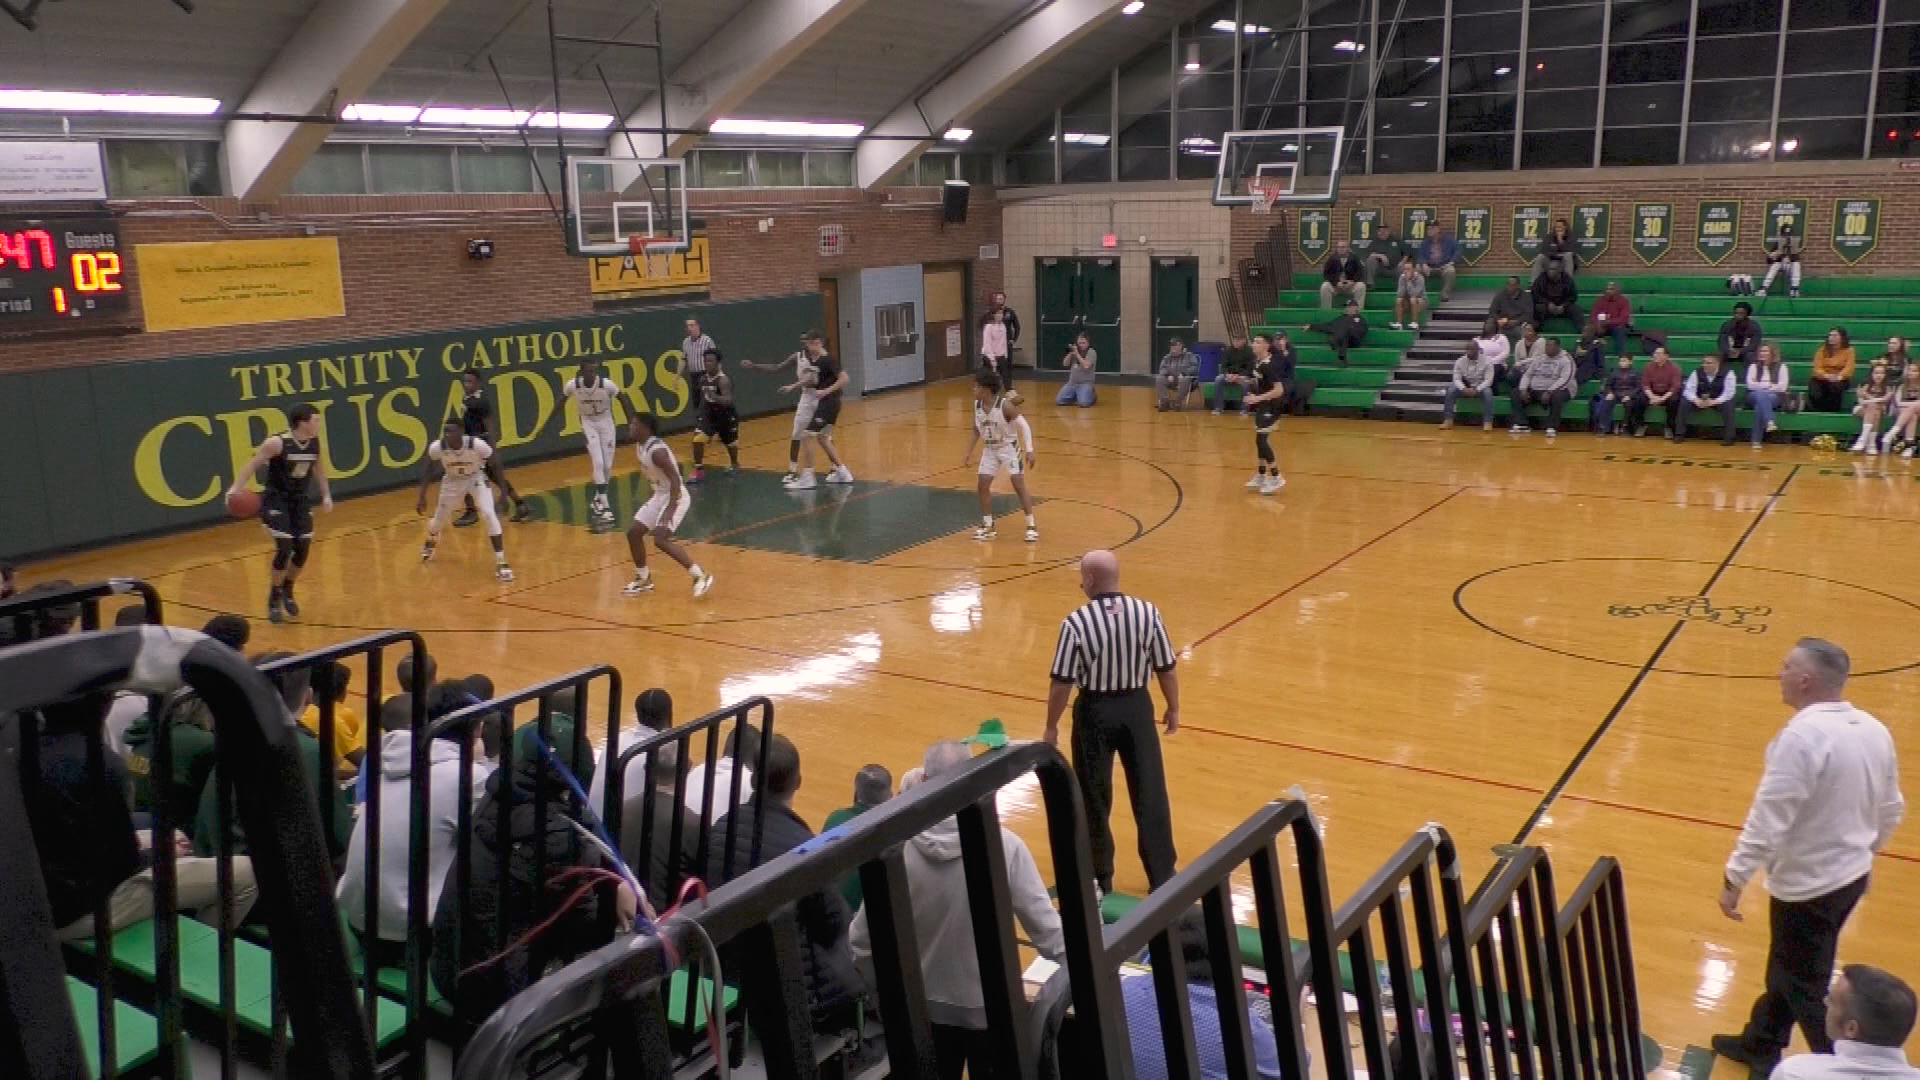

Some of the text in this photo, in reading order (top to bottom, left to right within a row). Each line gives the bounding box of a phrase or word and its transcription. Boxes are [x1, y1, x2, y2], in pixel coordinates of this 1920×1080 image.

[1465, 219, 1482, 239] 32
[1522, 219, 1539, 239] 12
[1585, 217, 1595, 238] 3
[1642, 217, 1662, 237] 30
[1844, 214, 1867, 235] 00
[65, 231, 115, 249] Guests
[71, 250, 122, 291] 02
[52, 286, 66, 313] 1
[231, 323, 625, 401] TRINITY CATHOLIC
